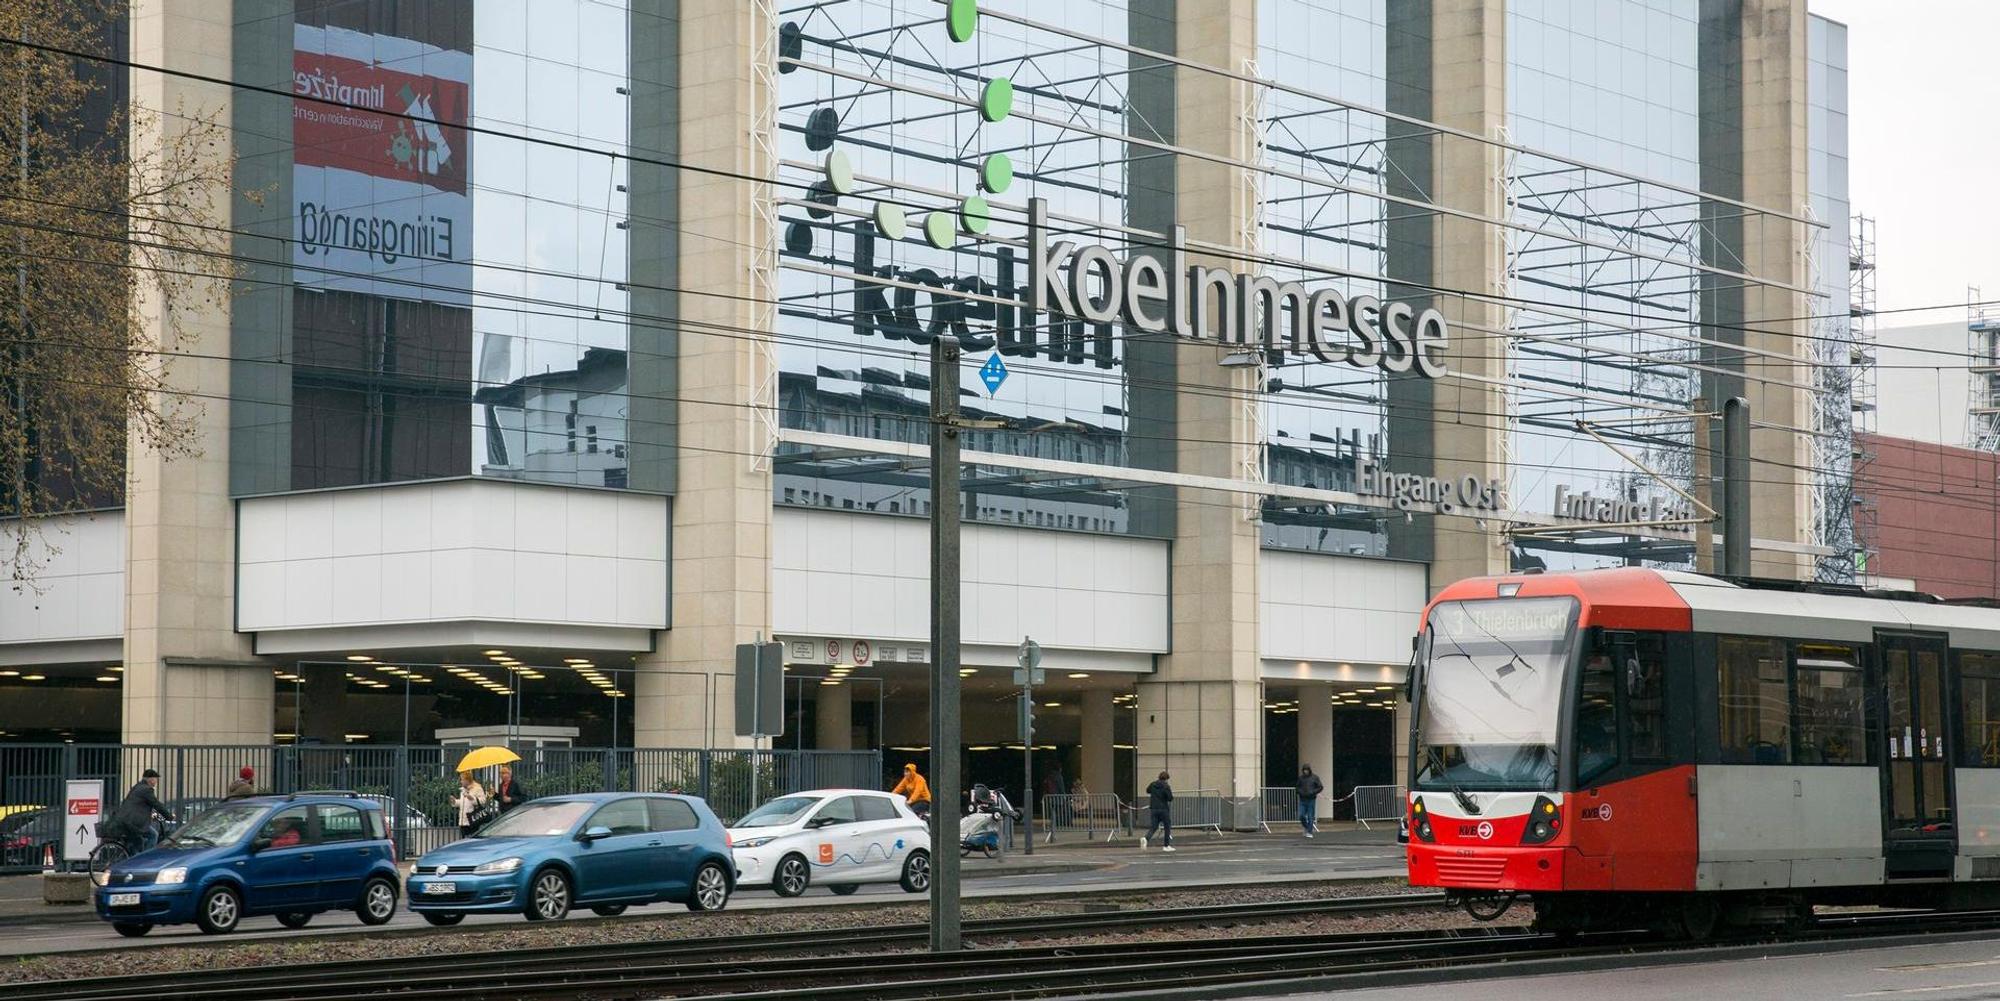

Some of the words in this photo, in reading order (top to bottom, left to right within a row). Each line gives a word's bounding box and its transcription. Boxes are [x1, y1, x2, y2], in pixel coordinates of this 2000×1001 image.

[1028, 198, 1449, 379] koelnmesse
[1355, 459, 1455, 514] Eingang
[1458, 473, 1500, 509] Ost
[1554, 484, 1650, 523] Entrance
[1453, 608, 1463, 635] 3
[1473, 608, 1567, 632] Thielenbruch
[1581, 807, 1600, 818] KVB
[1459, 825, 1478, 835] KVB
